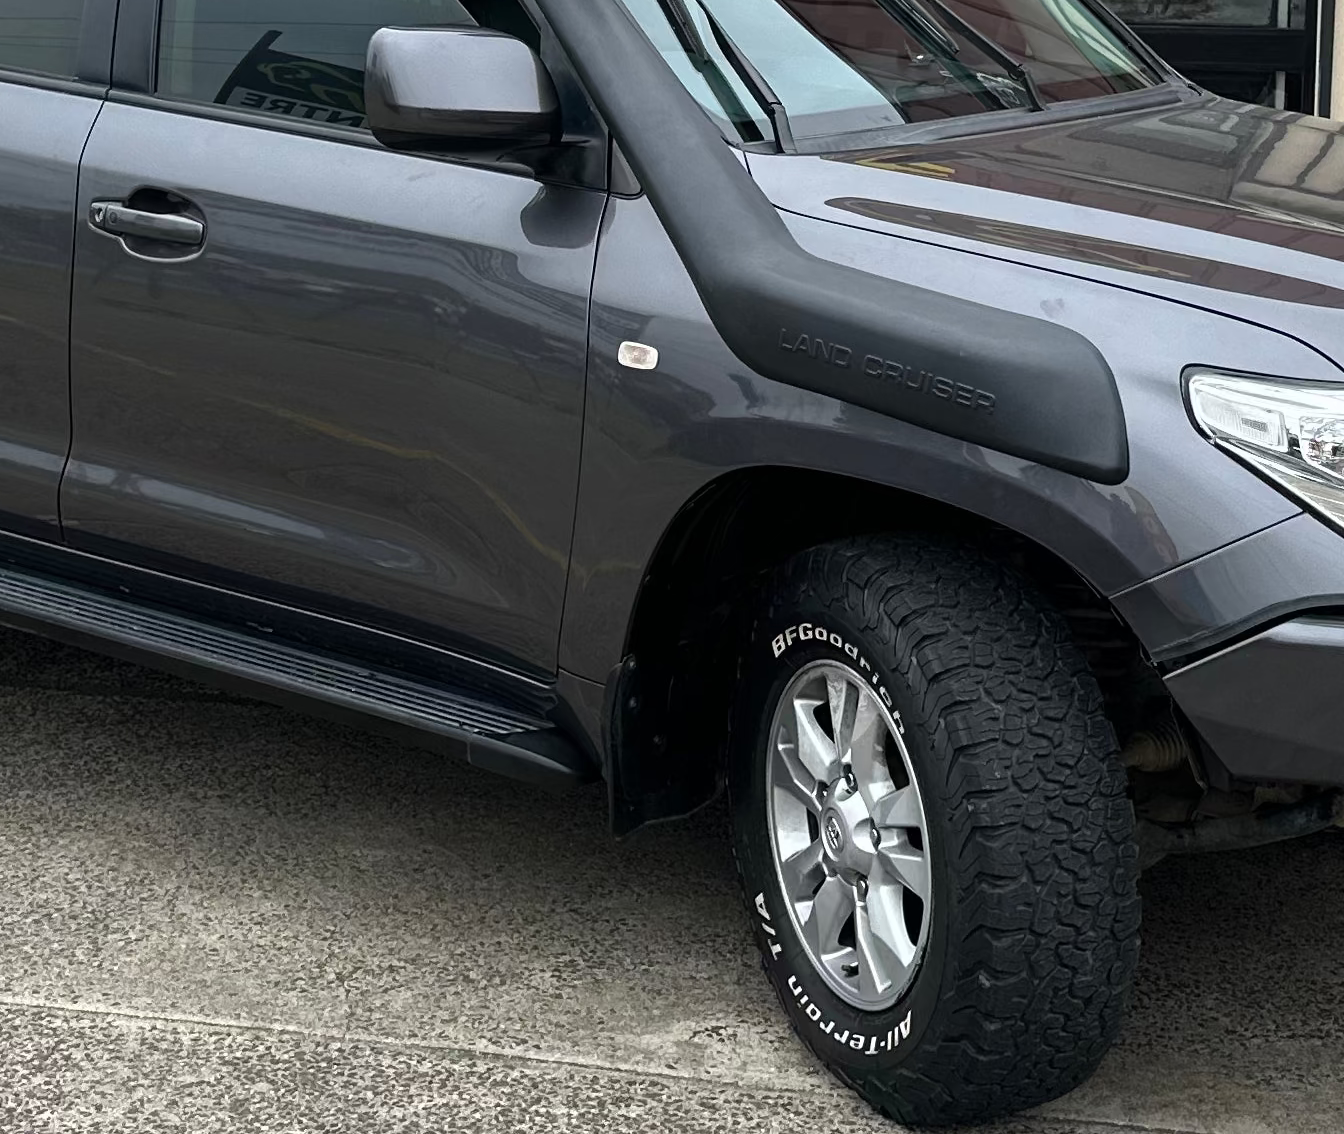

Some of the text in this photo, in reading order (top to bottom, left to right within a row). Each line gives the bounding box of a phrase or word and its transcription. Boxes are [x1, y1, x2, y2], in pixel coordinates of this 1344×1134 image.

[778, 327, 997, 416] LAND CRUISER
[771, 622, 906, 736] BFGoodrich
[755, 892, 913, 1055] All-Terrain T/A
